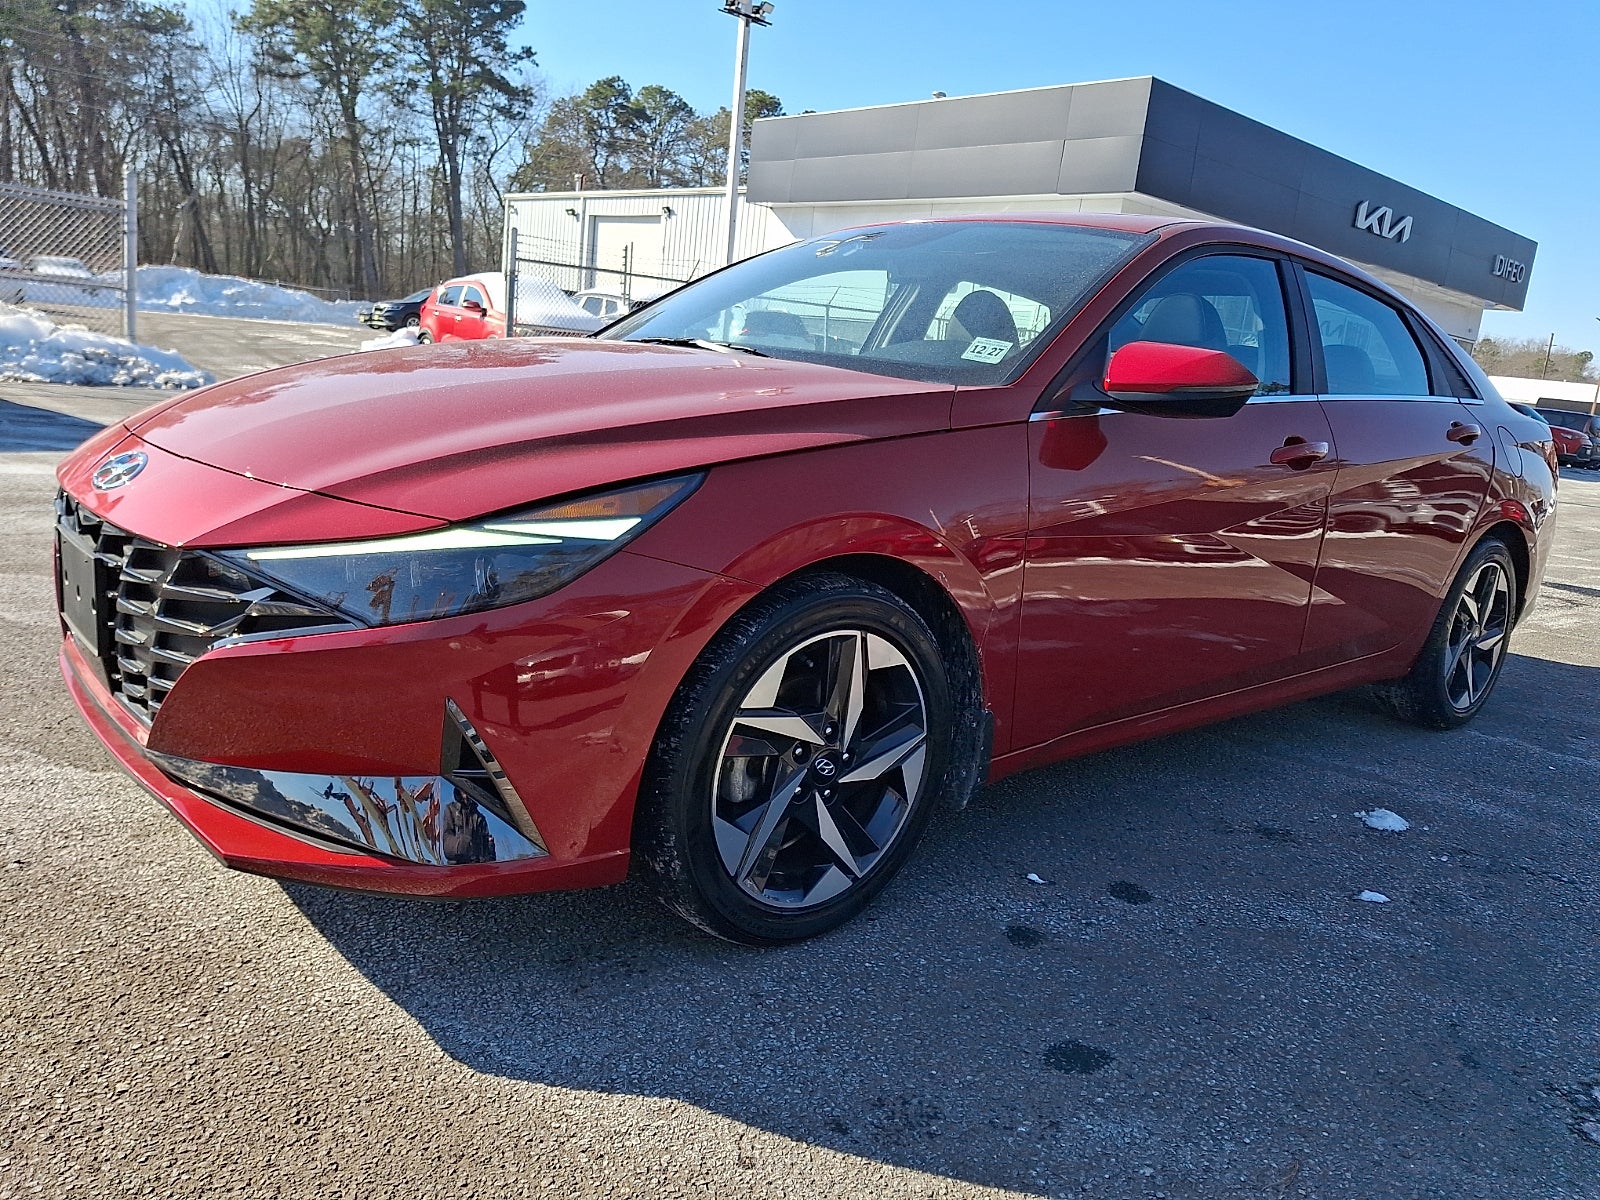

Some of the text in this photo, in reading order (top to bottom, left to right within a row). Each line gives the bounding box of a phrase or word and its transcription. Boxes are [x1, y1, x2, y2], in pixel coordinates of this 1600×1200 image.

[1355, 200, 1413, 243] KIA
[1494, 255, 1526, 283] DIFEO
[970, 344, 987, 354] 12
[987, 347, 1005, 357] 27
